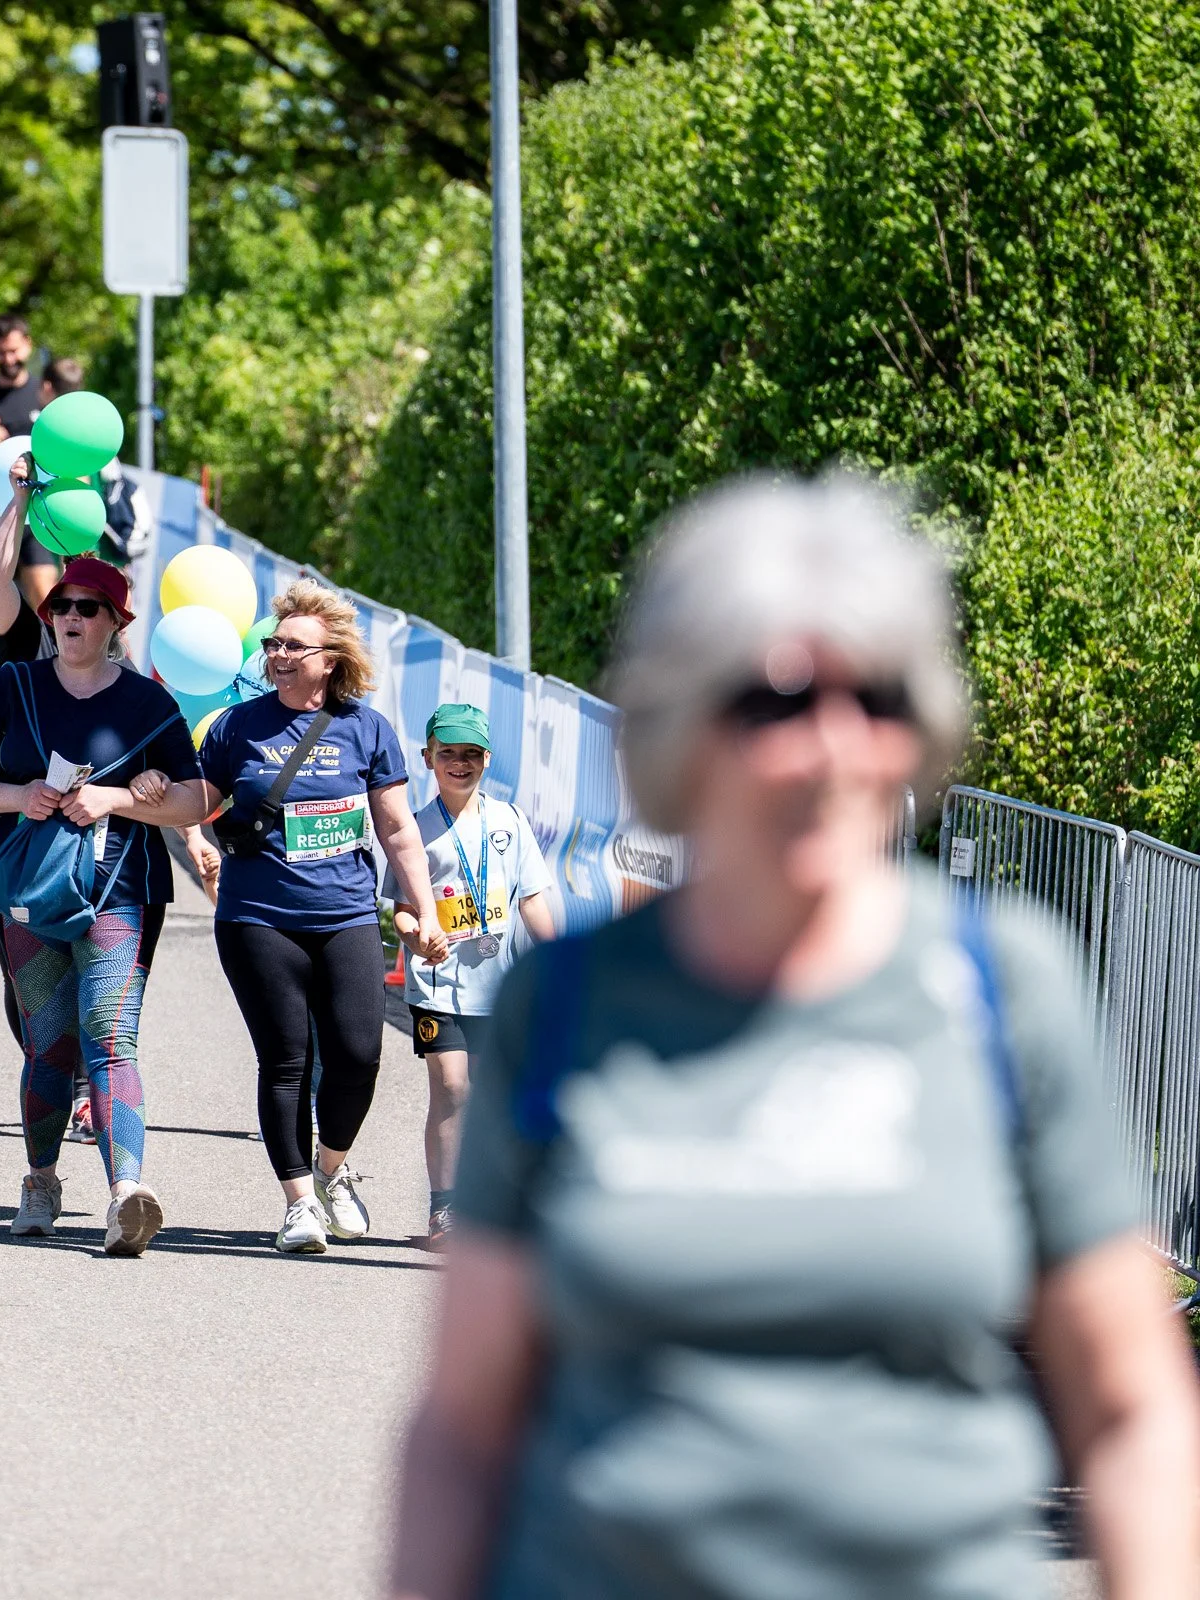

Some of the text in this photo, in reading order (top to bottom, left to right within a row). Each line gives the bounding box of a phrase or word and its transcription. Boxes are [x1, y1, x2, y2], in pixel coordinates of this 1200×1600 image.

[280, 745, 340, 757] CHITZER
[314, 817, 340, 831] 439
[296, 827, 356, 848] REGINA
[296, 851, 319, 860] valiant
[451, 907, 503, 929] JAKOB
